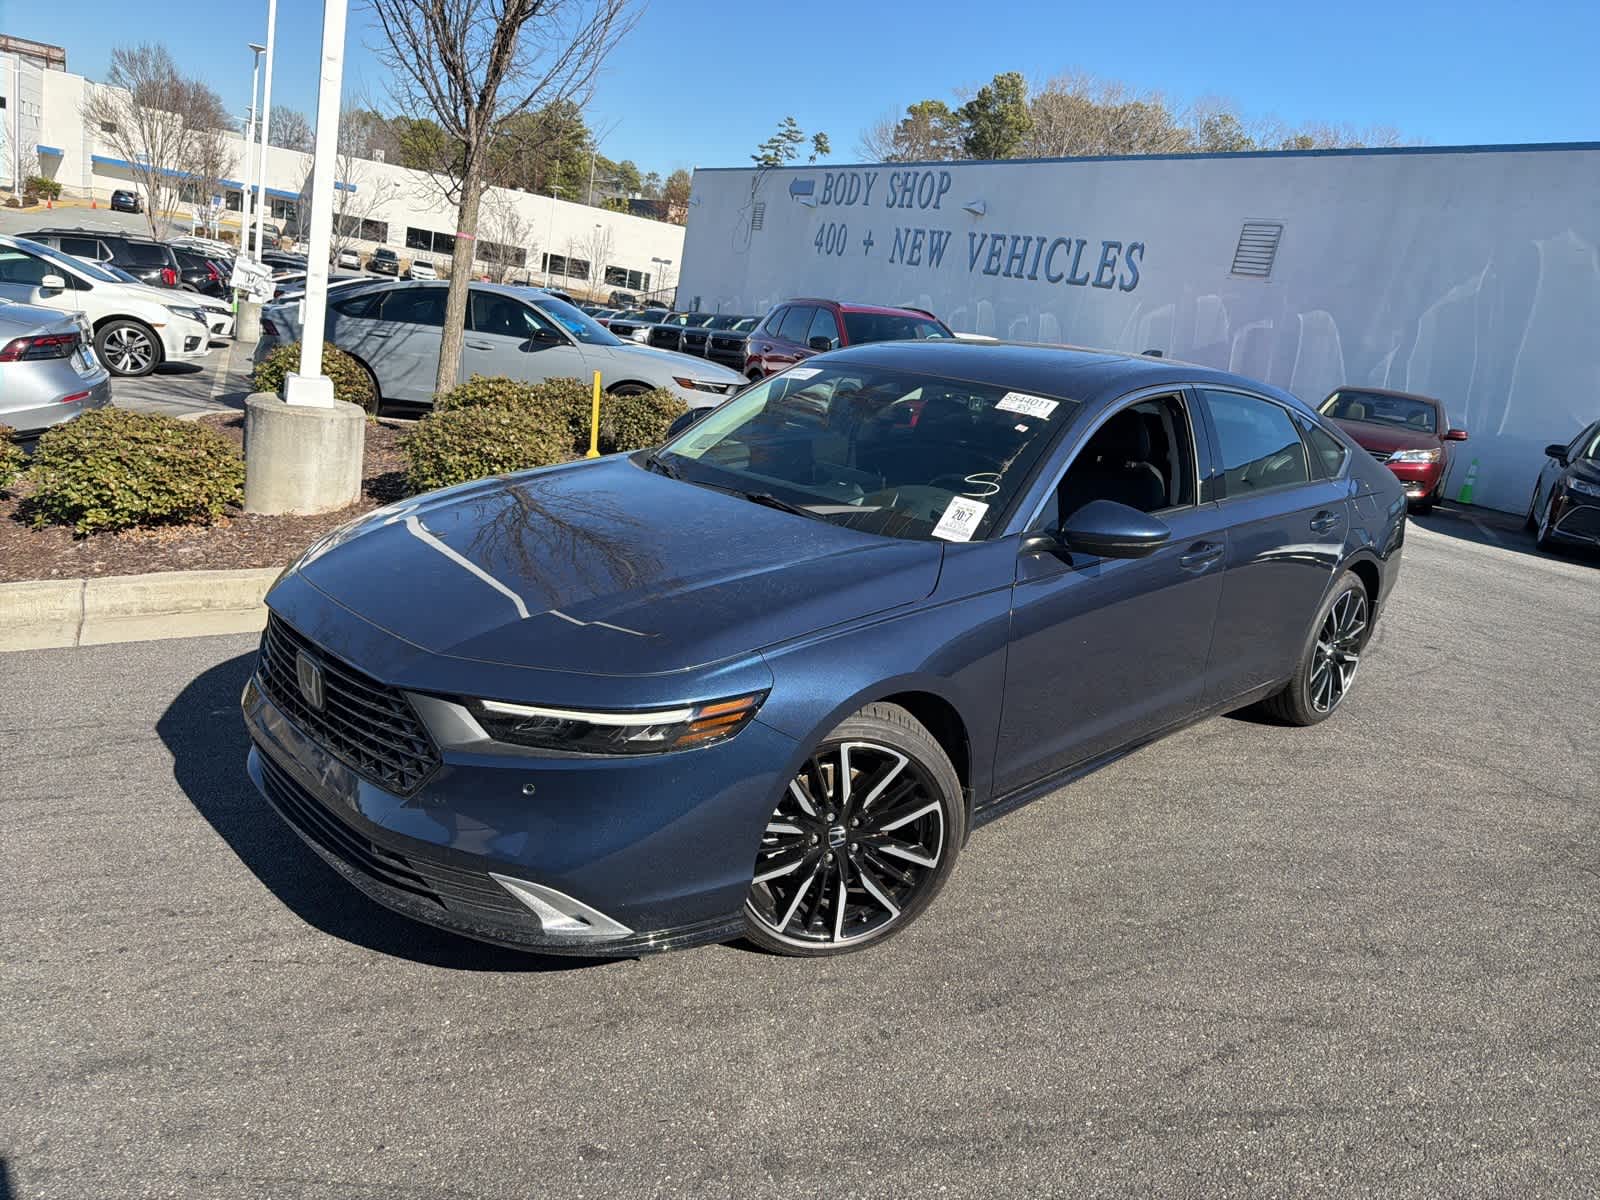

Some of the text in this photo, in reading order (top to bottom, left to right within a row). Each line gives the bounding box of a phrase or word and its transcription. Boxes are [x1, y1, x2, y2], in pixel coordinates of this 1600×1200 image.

[820, 170, 951, 210] BODY SHOP
[814, 223, 848, 257] 400
[888, 227, 952, 269] NEW
[968, 232, 1145, 293] VEHICLES
